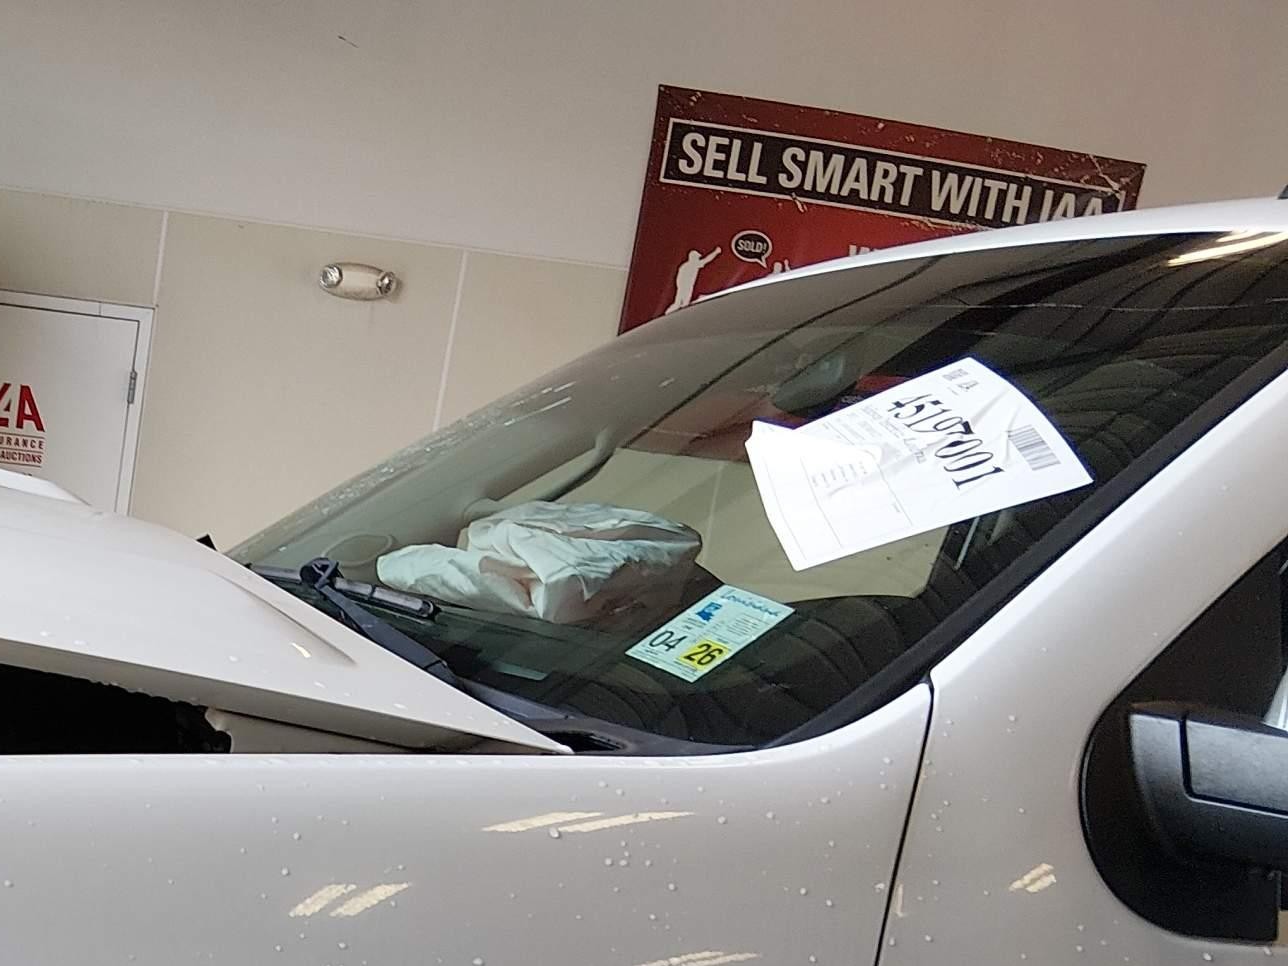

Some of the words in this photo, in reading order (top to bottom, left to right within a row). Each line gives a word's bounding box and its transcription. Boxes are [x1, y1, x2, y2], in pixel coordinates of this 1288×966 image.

[678, 131, 768, 186] SELL
[778, 146, 923, 207] SMART
[931, 169, 1033, 226] WITH
[737, 239, 768, 254] SOLD!
[887, 393, 1005, 490] 45197001
[0, 450, 43, 465] AUCTIONS
[648, 629, 689, 653] 04
[684, 642, 725, 666] 26
